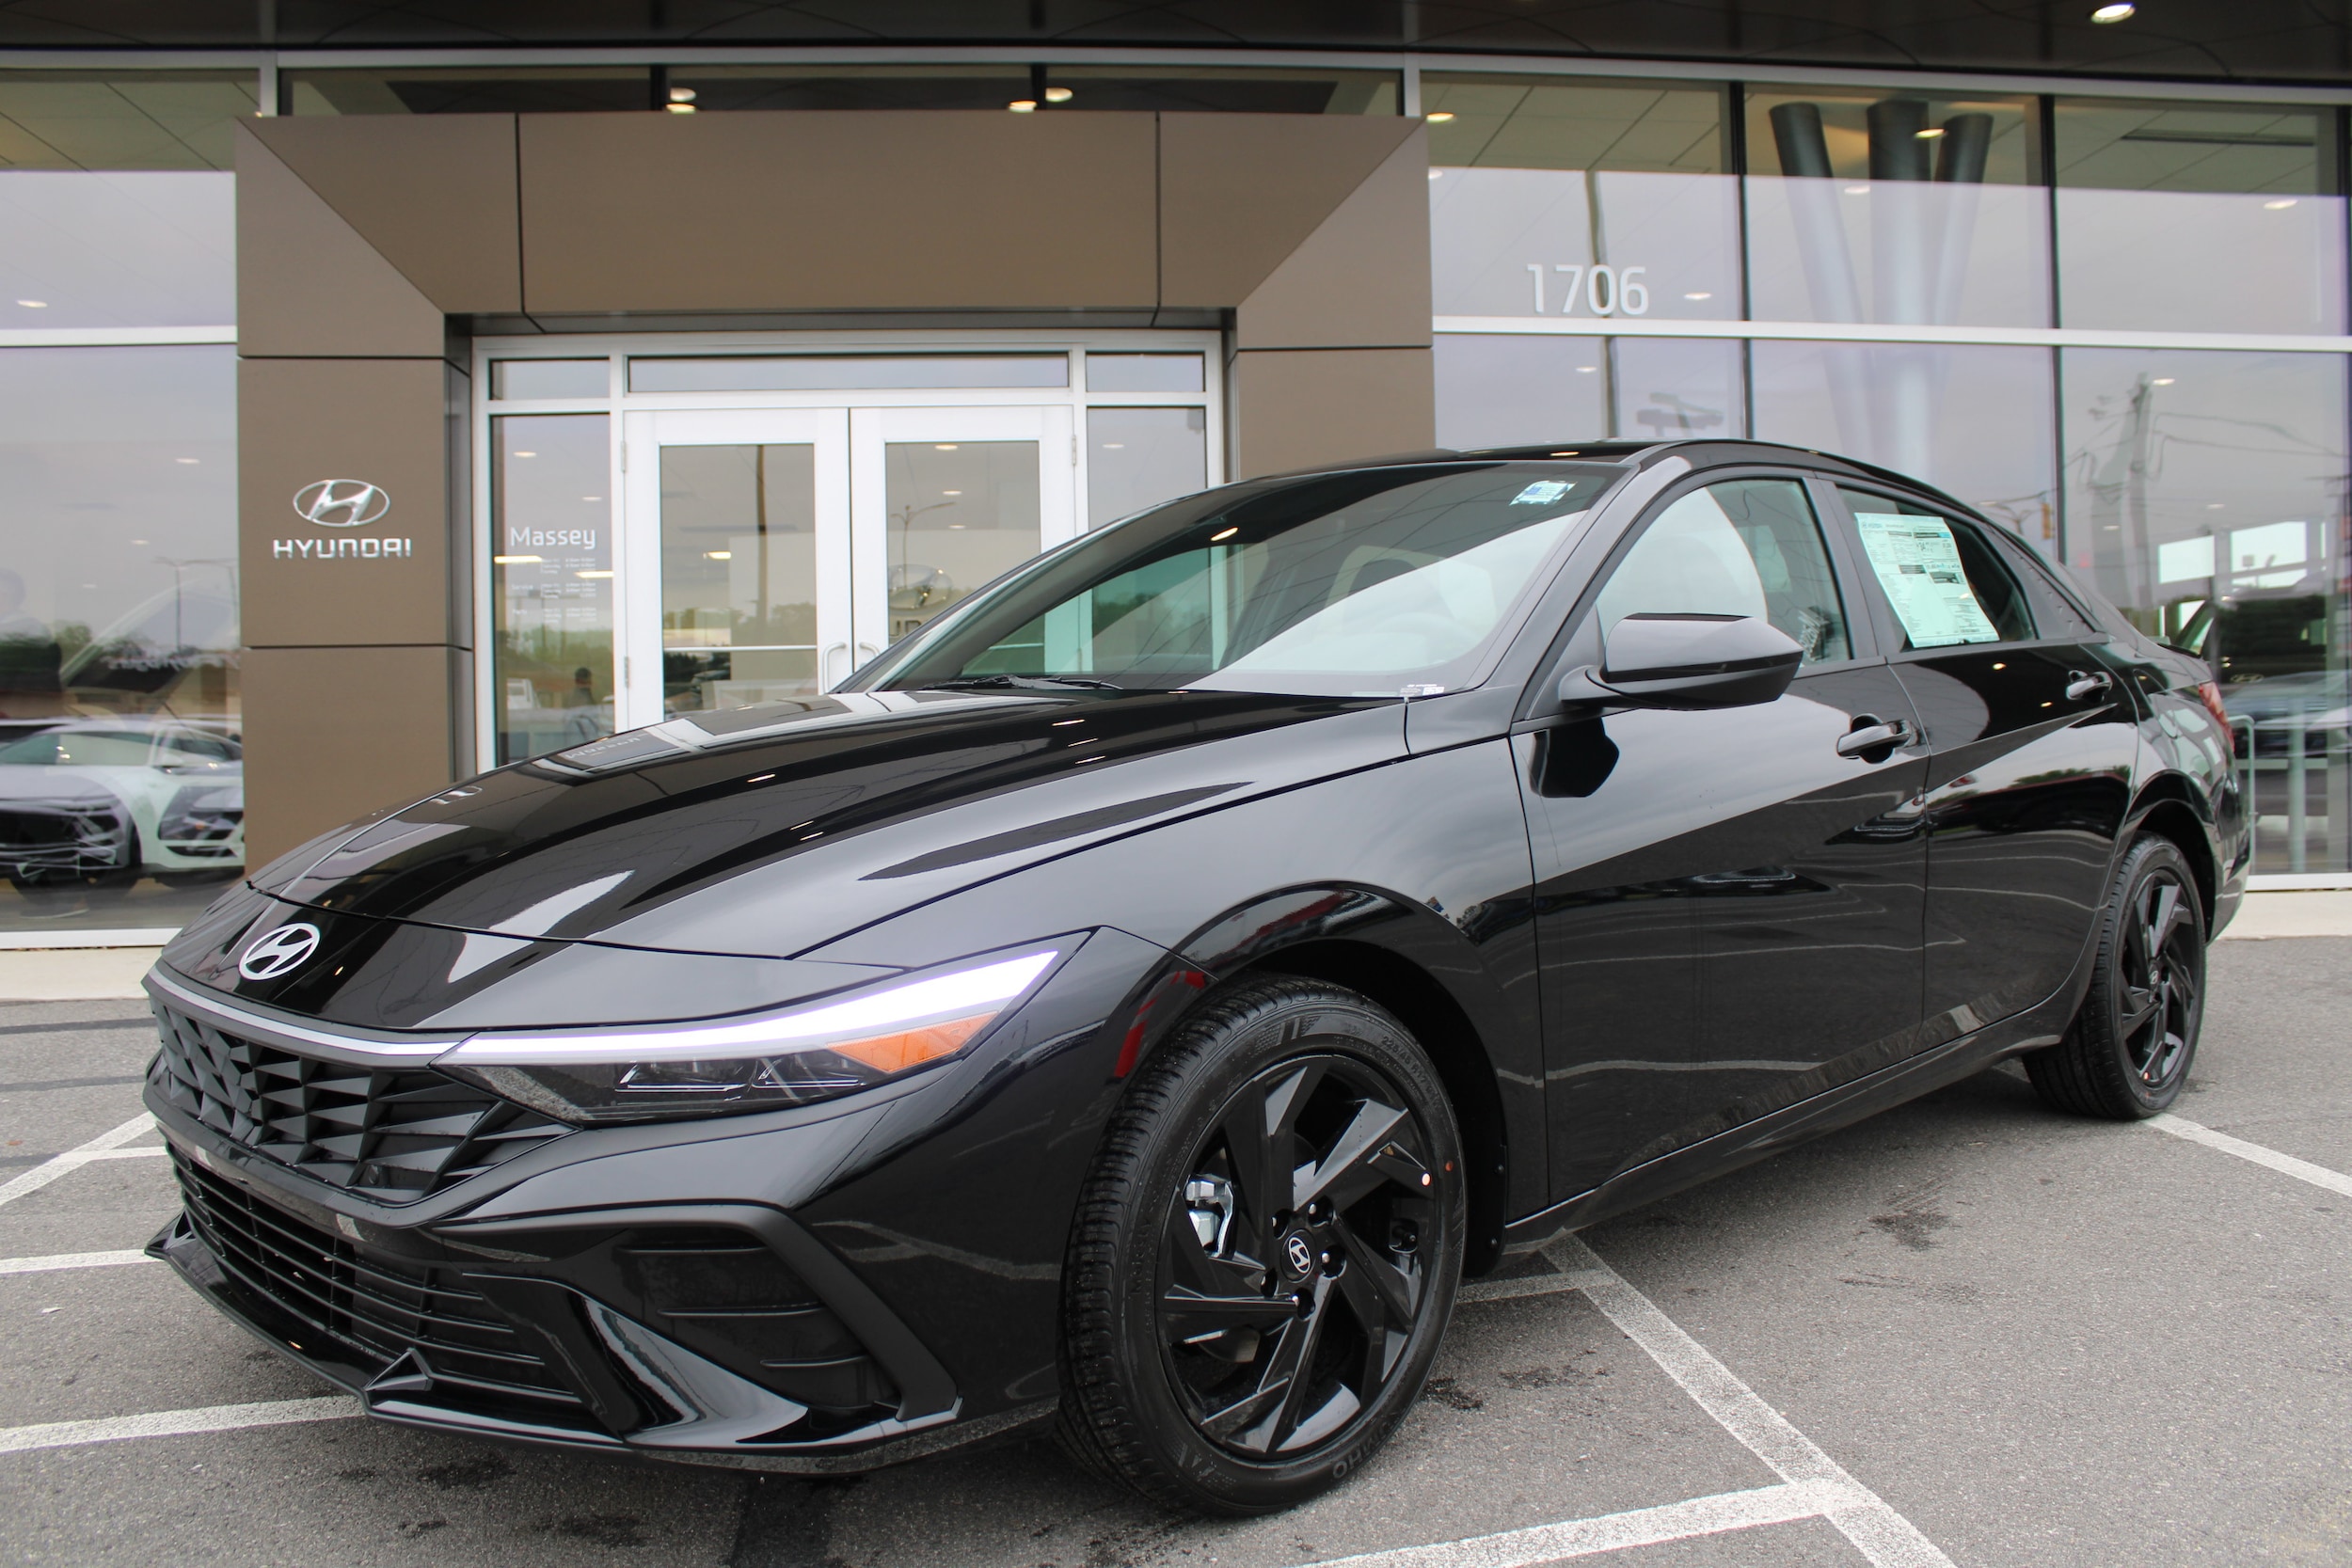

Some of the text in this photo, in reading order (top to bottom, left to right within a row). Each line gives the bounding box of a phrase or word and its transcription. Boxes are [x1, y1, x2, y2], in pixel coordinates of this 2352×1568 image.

[1527, 263, 1649, 315] 1706
[273, 537, 411, 559] HYUNDAI
[510, 526, 596, 550] Massey
